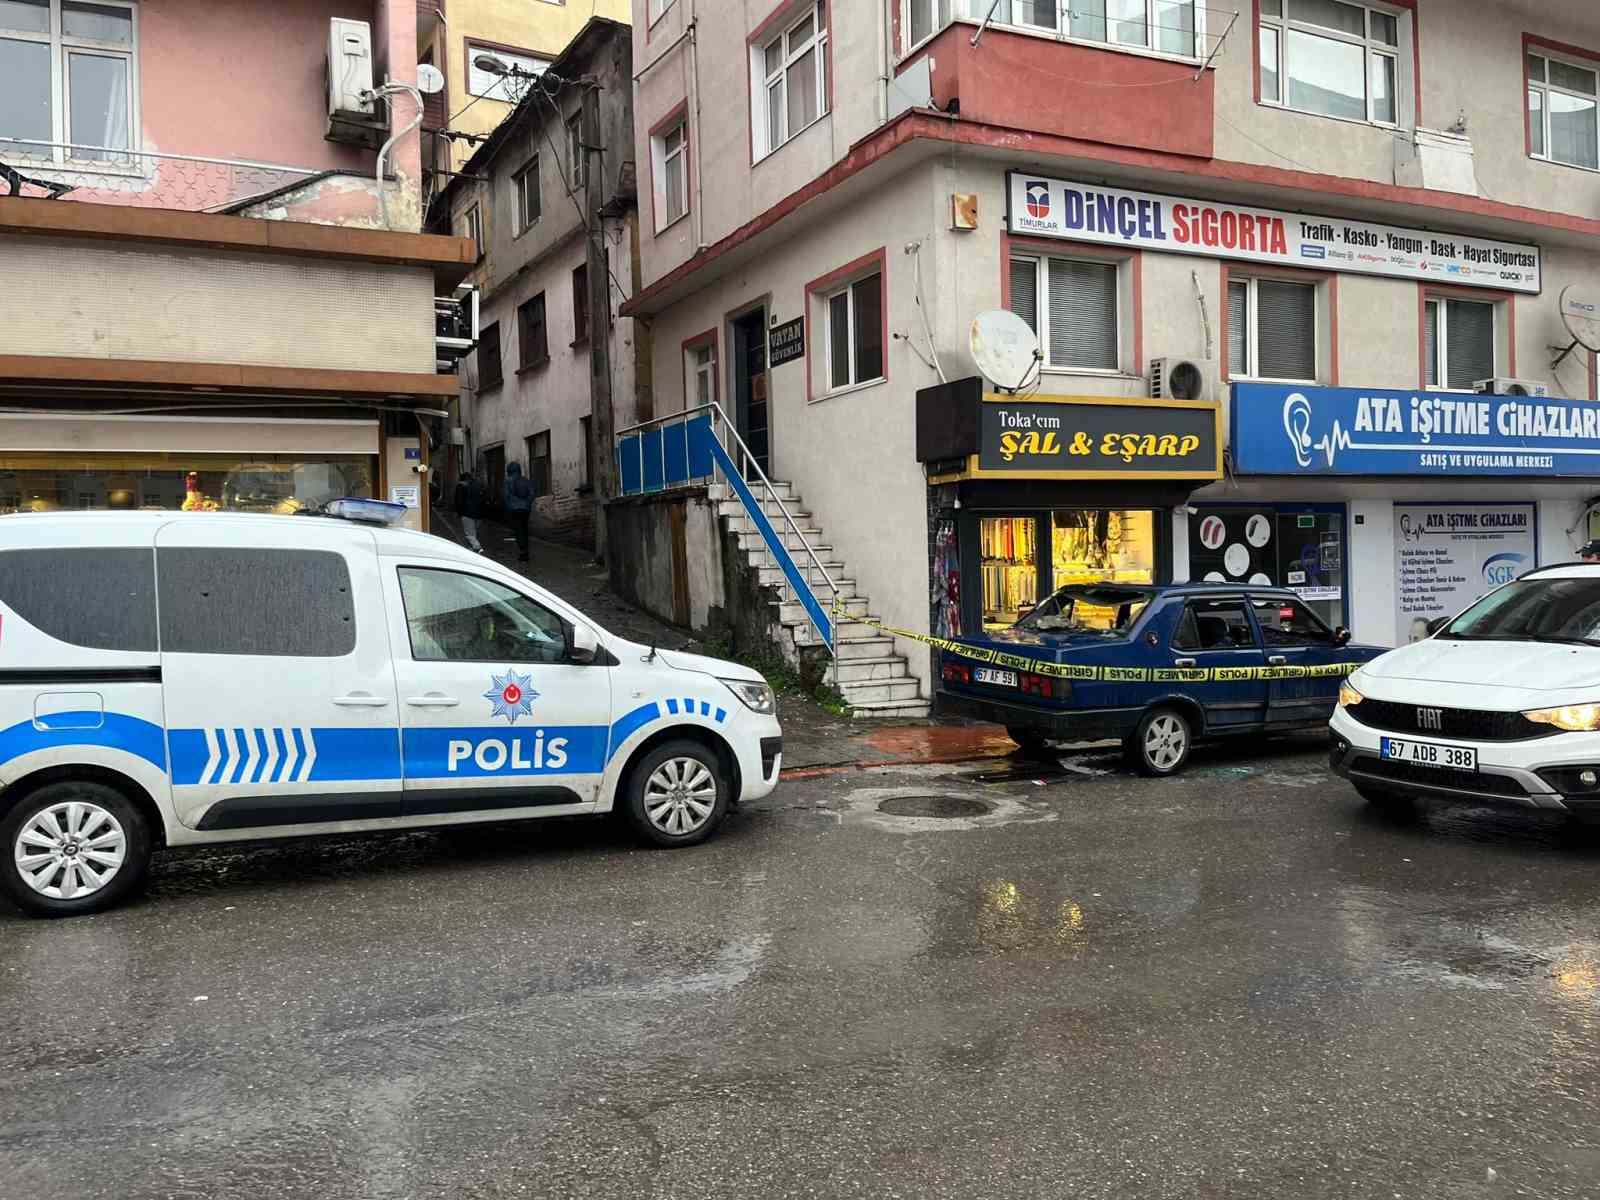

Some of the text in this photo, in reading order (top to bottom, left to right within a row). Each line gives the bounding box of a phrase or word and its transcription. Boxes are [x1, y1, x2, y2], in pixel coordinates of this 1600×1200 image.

[1064, 188, 1287, 255] DİNÇEL SİGORTA
[1300, 221, 1536, 268] Trafik Kasko Yangın Dask Hayat Sigortası
[1354, 397, 1403, 433] ATA
[1411, 396, 1490, 443] İŞİTME
[999, 431, 1200, 463] ŞAL & EŞARP
[1420, 453, 1447, 470] SATIŞ
[1449, 454, 1461, 466] VE
[1463, 454, 1514, 467] UYGULAMA
[1487, 566, 1516, 585] SGK
[977, 668, 1016, 686] 67 AF 591
[1416, 706, 1443, 730] FIAT
[448, 729, 569, 772] POLİS
[1389, 742, 1405, 758] 67
[1412, 745, 1438, 762] ADB
[1445, 749, 1472, 767] 388
